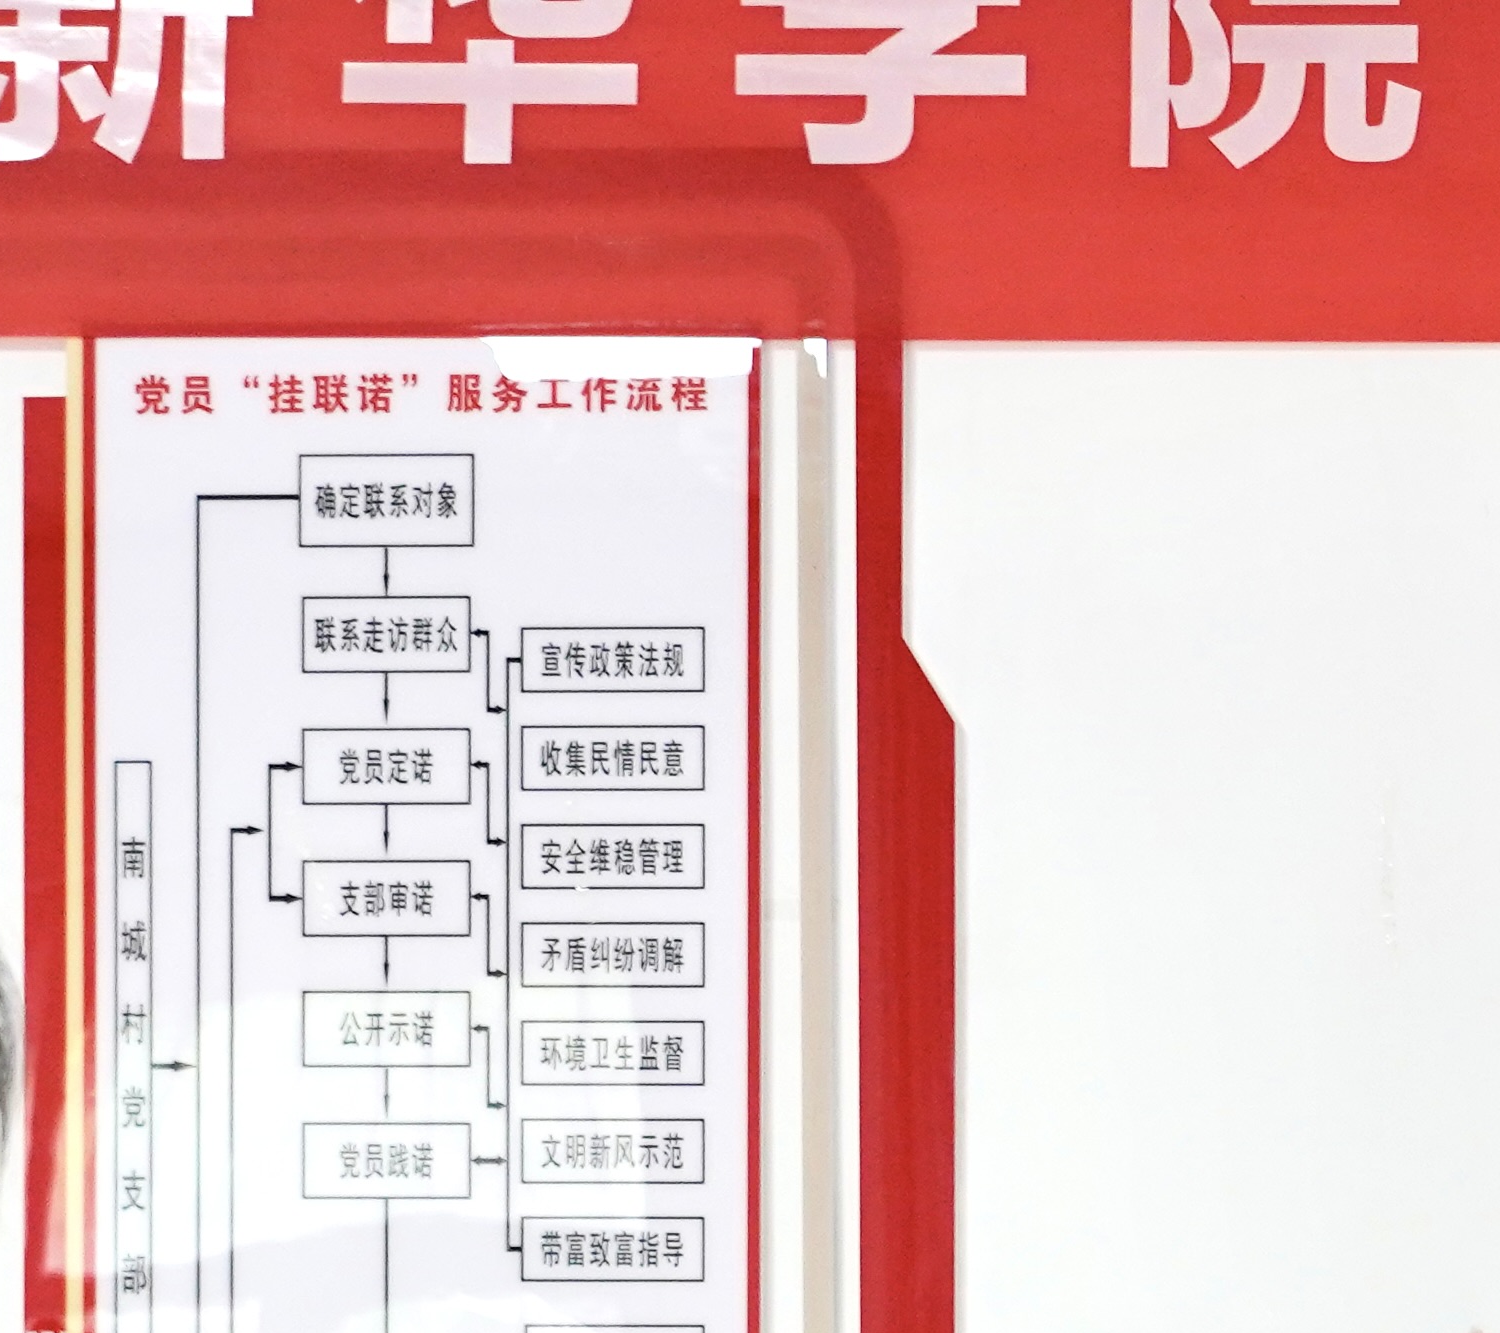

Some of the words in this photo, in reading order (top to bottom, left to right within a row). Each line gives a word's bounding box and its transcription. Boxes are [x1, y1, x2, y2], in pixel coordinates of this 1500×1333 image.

[315, 483, 457, 518] 确定联系对象
[315, 617, 457, 653] 联系走访群众
[542, 642, 684, 678] 宣传政策法规
[340, 749, 433, 784] 党员定诺
[541, 740, 684, 776] 收集民情民意
[541, 839, 683, 875] 安全维稳管理
[340, 881, 433, 916] 支部审诺
[542, 937, 684, 972] 矛盾纠纷调解
[341, 1012, 433, 1045] 公开示诺
[122, 838, 147, 1296] 南城村党支部
[541, 1036, 683, 1071] 环境卫生监督
[341, 1144, 432, 1177] 党员践诺
[542, 1134, 684, 1169] 文明新风示范
[541, 1231, 683, 1267] 带富致富指导
